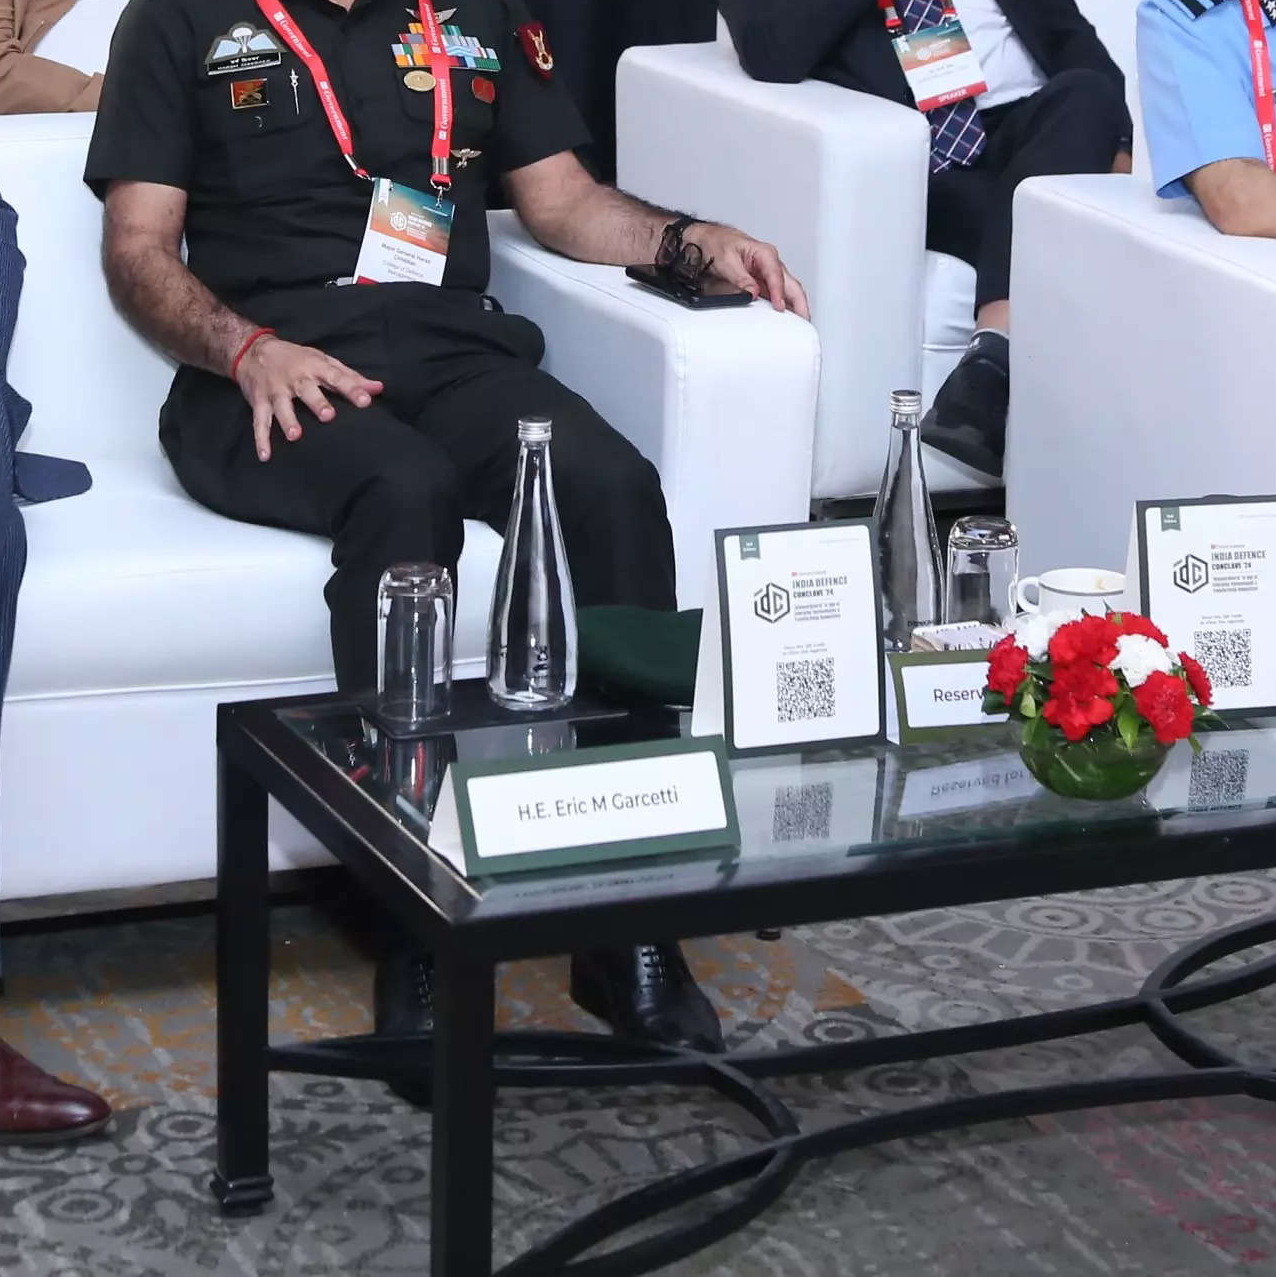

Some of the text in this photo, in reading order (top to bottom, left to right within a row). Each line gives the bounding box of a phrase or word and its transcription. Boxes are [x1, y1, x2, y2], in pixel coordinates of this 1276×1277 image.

[1211, 549, 1266, 561] INDIA DEFENCE
[792, 576, 848, 589] INDIA DEFENCE
[933, 688, 984, 703] Reserv
[517, 784, 679, 822] H.E. Eric M Garcetti
